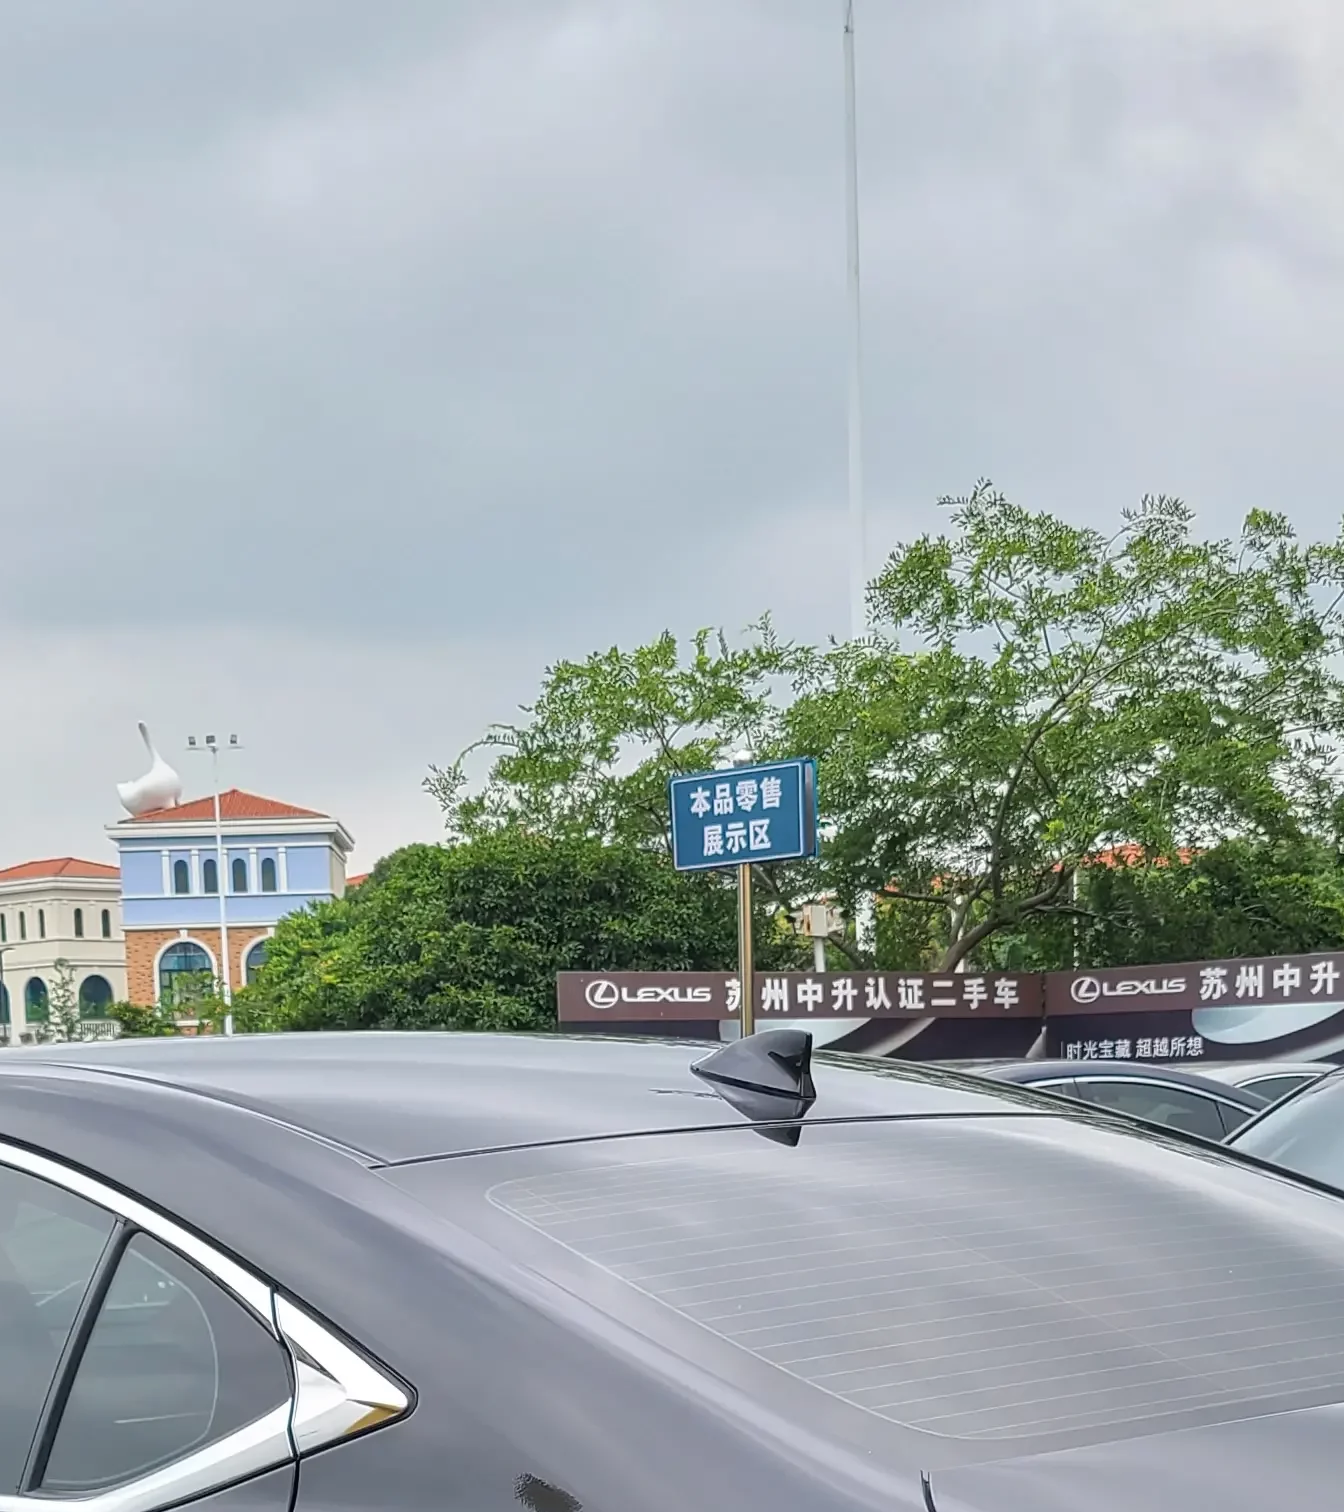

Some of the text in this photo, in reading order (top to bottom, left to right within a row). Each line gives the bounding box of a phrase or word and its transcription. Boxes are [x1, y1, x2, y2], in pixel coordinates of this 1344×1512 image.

[689, 776, 782, 818] 本品零售
[703, 818, 772, 857] 展示区
[621, 986, 712, 1003] LEXUS
[1102, 978, 1187, 997] LEXUS
[1135, 1036, 1204, 1059] 超越所想
